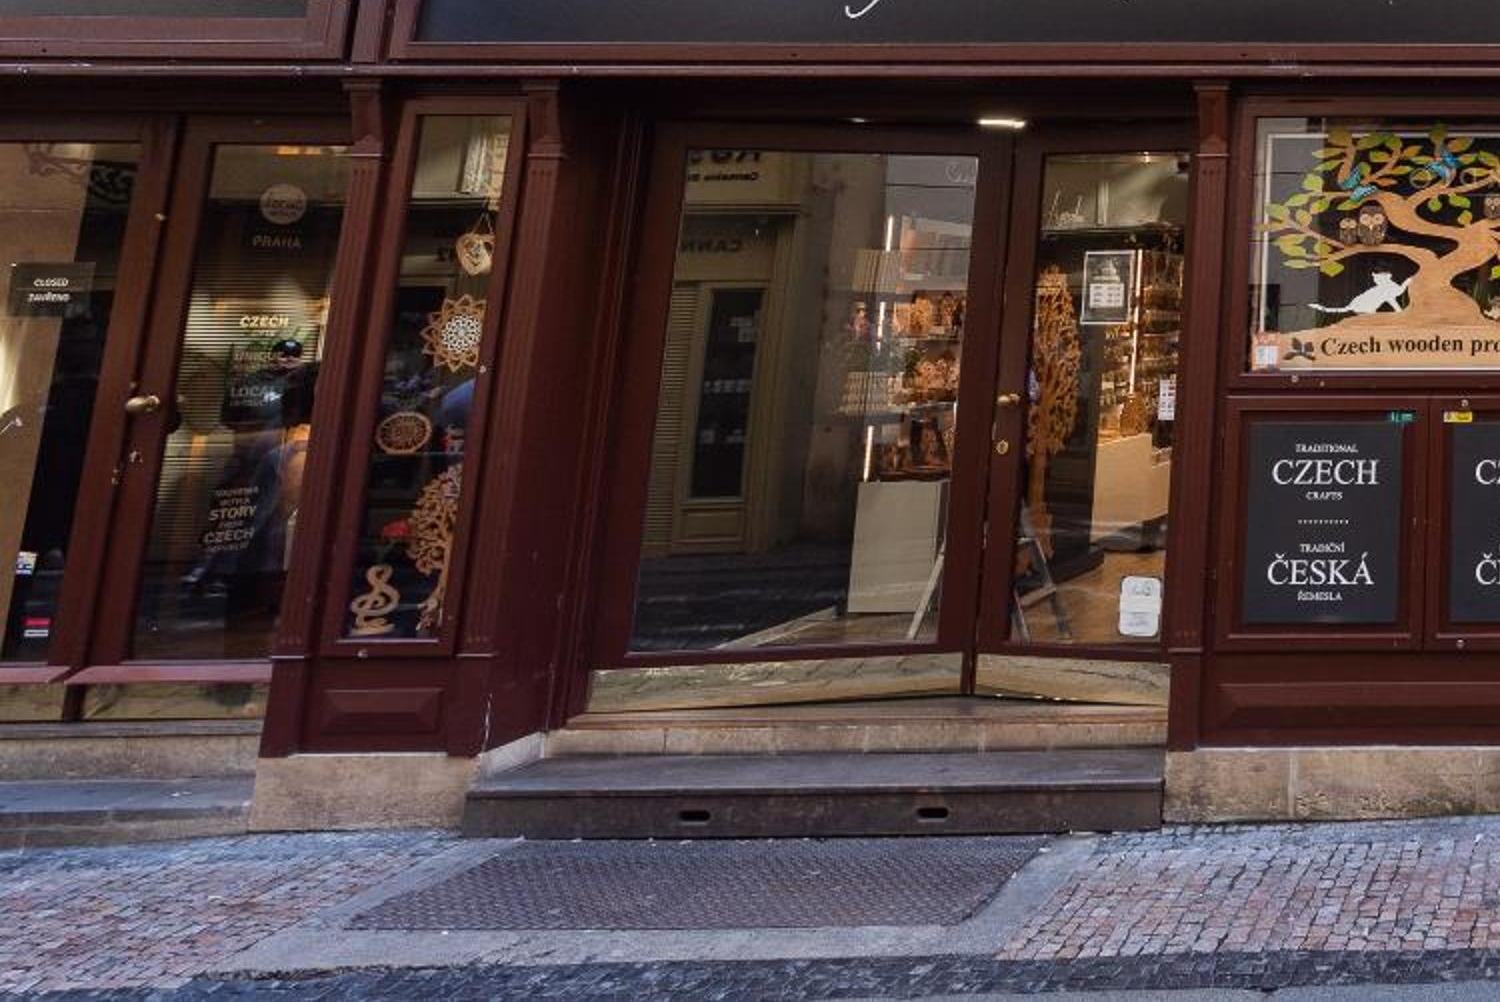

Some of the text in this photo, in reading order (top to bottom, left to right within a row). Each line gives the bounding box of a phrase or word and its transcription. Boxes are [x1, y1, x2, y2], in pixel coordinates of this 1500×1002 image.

[1320, 336, 1382, 356] Czech
[1388, 335, 1464, 354] wooden
[1295, 443, 1359, 453] TRADITIONAL
[1271, 459, 1380, 485] CZECH
[1305, 491, 1343, 501] CRAFTS
[1267, 551, 1375, 586] ČESKÁ
